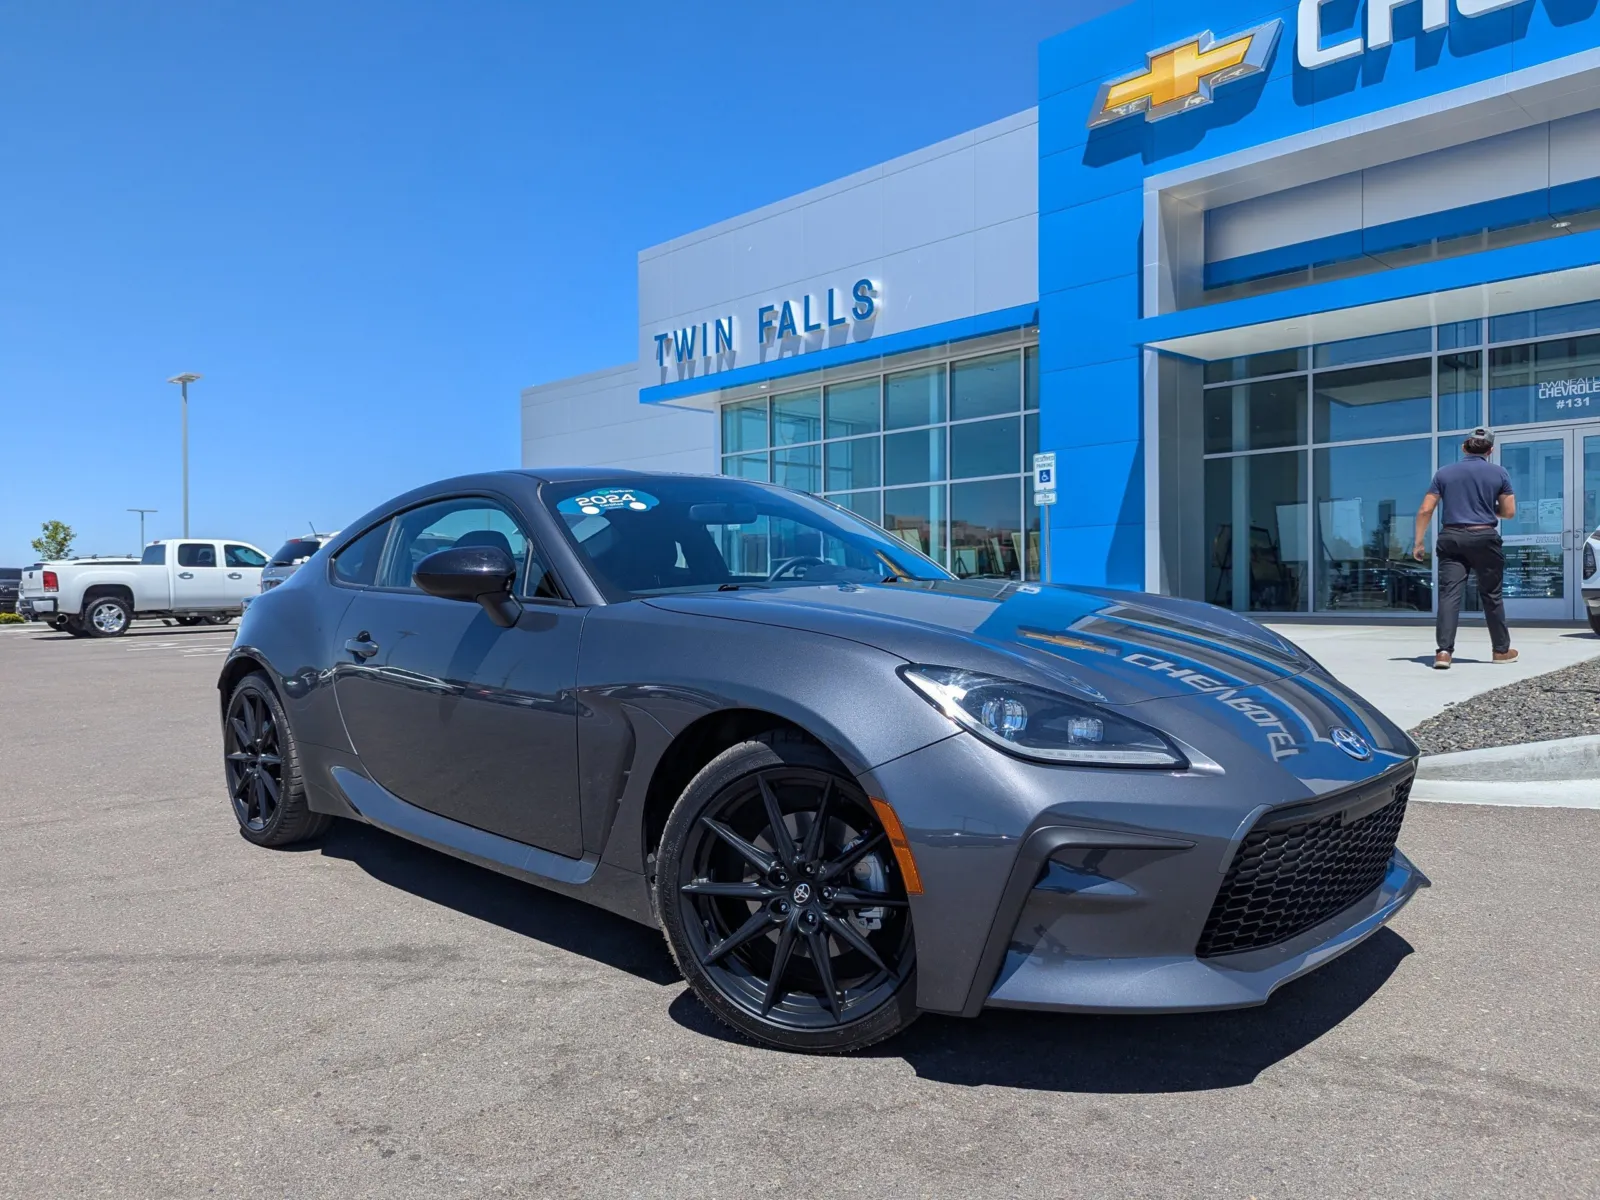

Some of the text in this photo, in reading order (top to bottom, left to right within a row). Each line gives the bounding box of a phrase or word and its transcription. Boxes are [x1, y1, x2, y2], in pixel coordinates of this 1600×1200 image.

[654, 278, 880, 367] TWIN FALLS
[1556, 397, 1590, 409] #131
[575, 493, 636, 507] 2024
